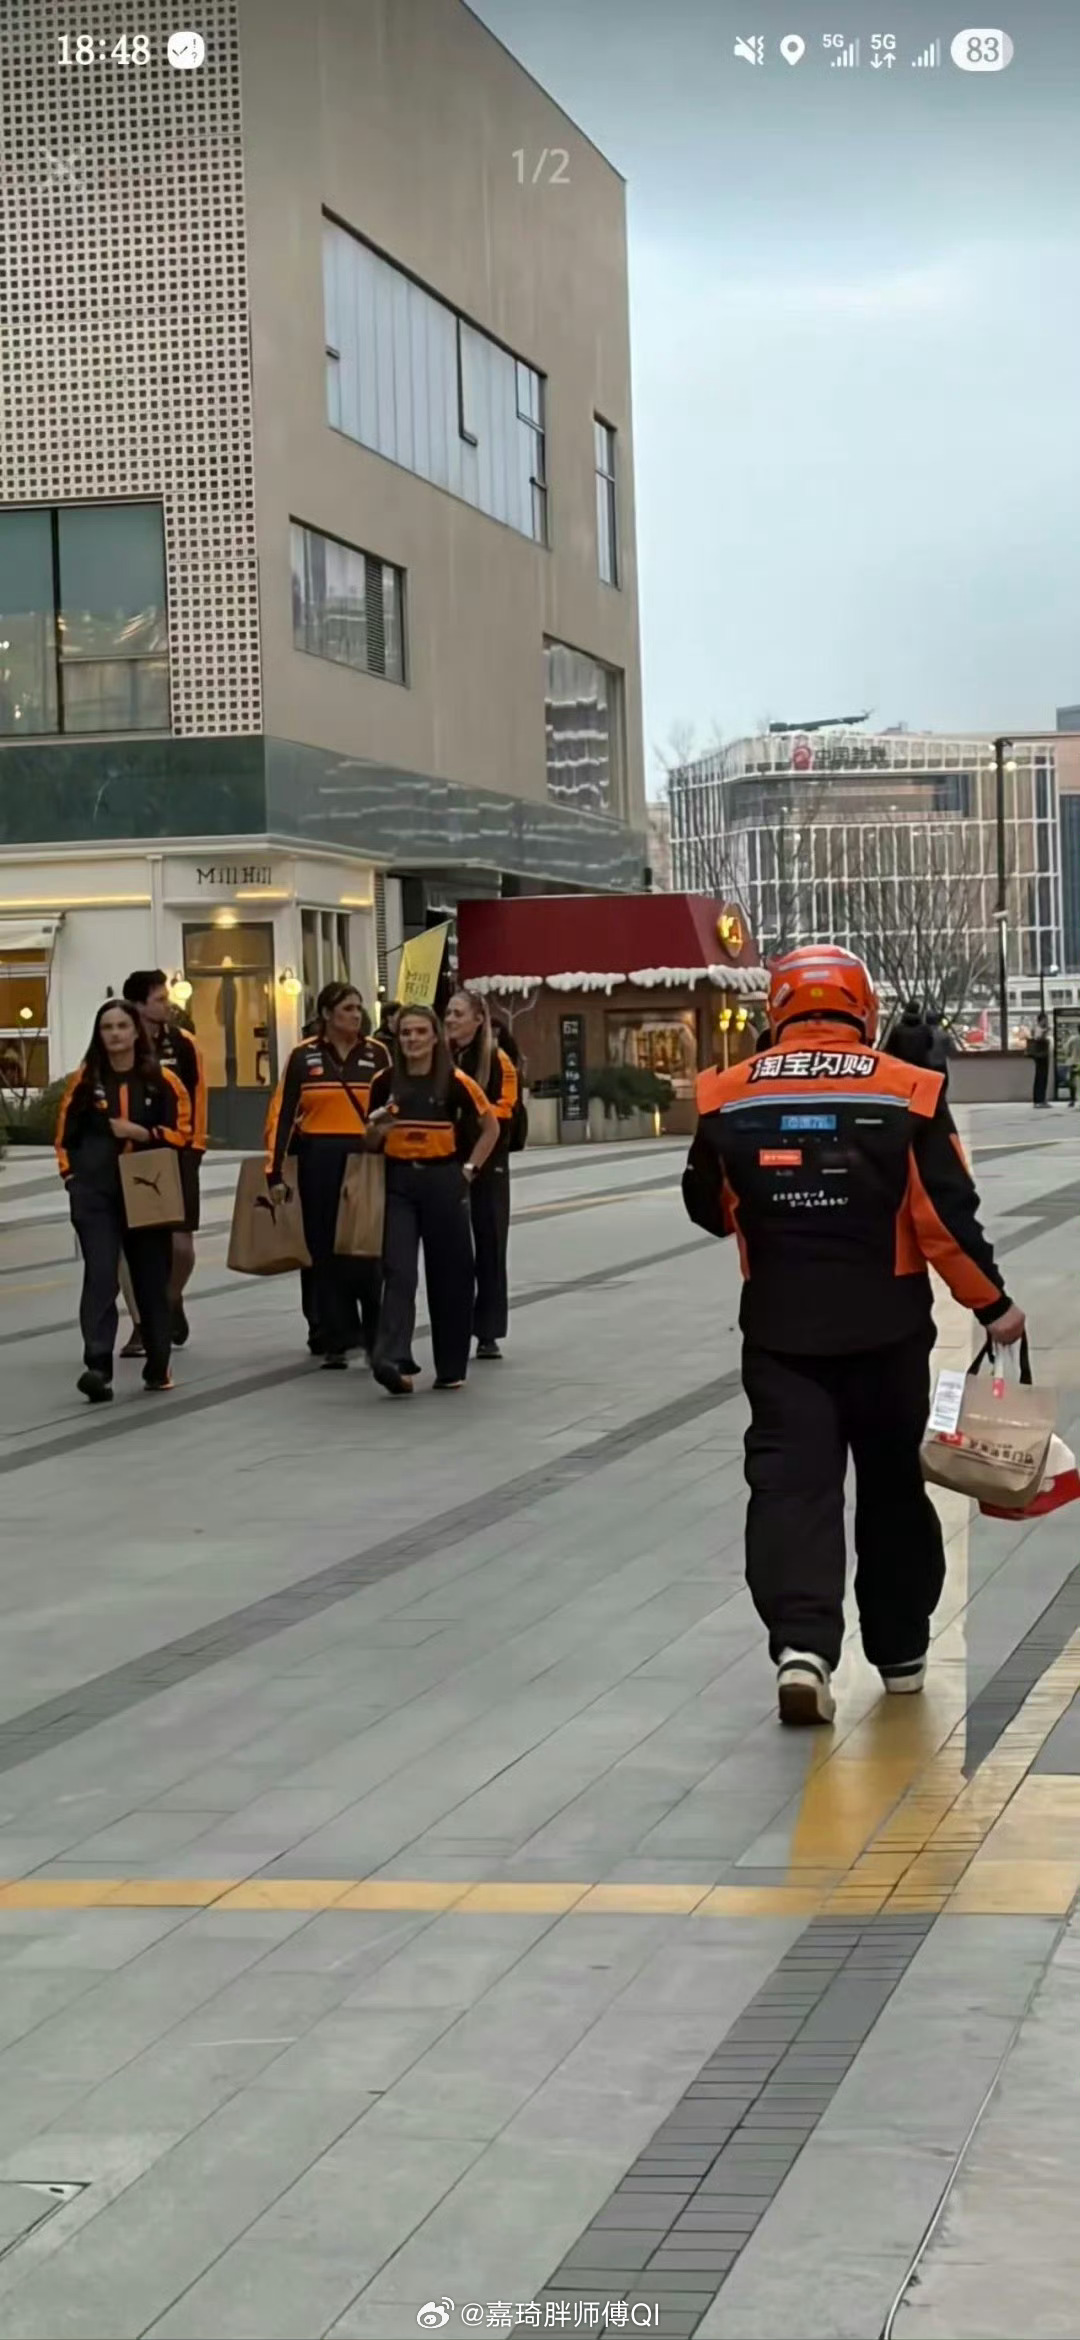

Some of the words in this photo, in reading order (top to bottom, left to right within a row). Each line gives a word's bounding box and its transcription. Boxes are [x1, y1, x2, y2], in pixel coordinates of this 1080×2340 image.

[196, 866, 238, 885] Mill
[242, 866, 272, 885] Hill
[751, 1051, 875, 1081] 淘宝闪购
